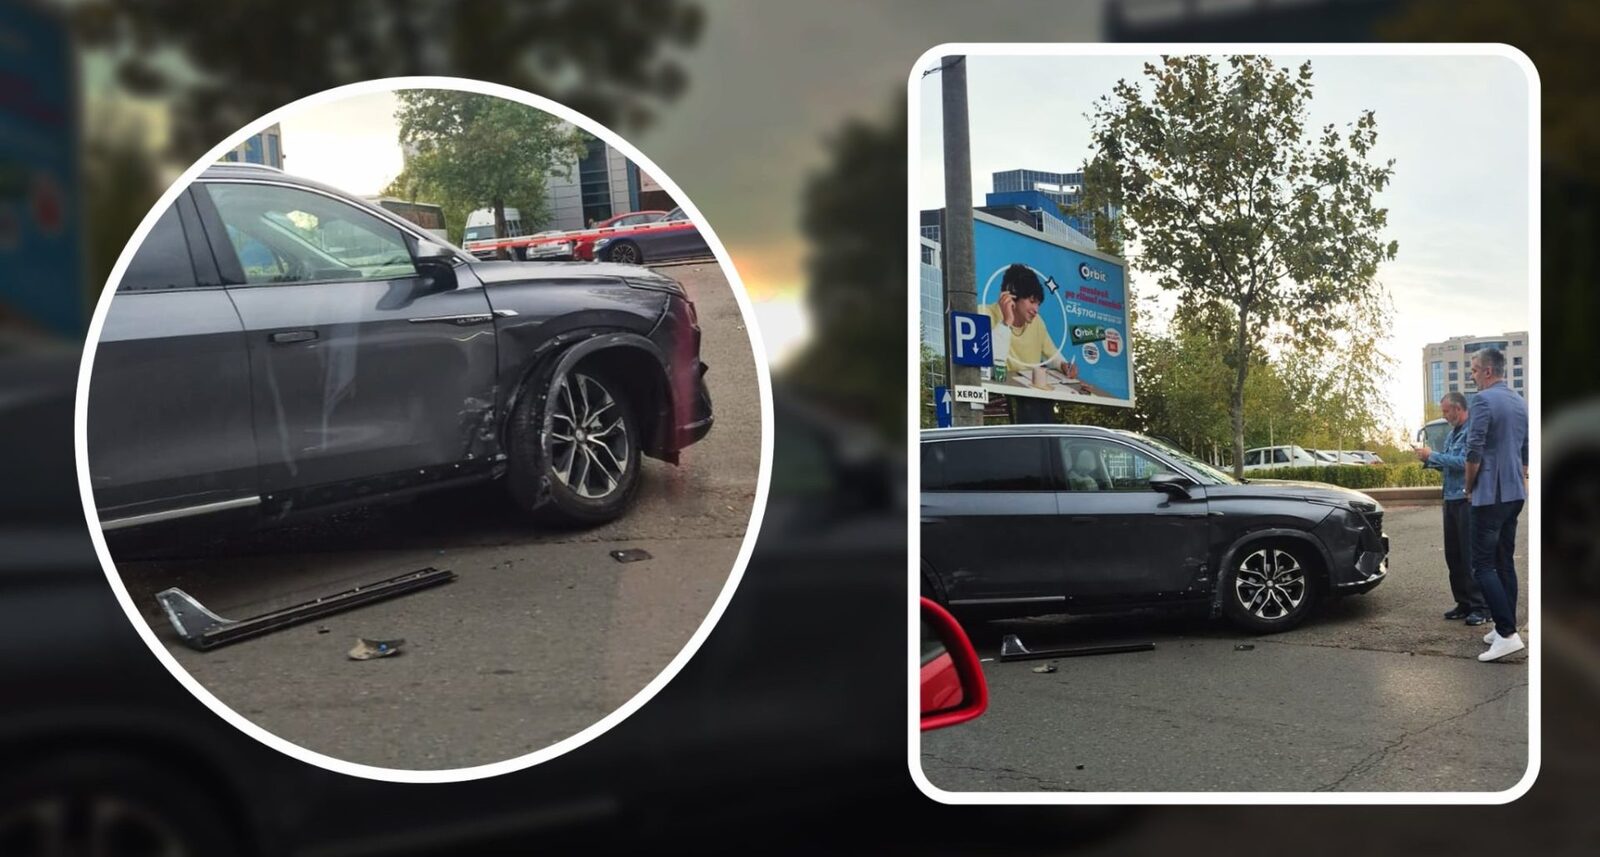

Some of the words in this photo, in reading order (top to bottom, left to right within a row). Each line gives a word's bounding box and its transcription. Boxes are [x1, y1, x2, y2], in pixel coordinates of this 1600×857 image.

[1081, 265, 1106, 282] Orbit
[954, 315, 976, 358] P
[1074, 327, 1093, 338] Orbit
[957, 389, 983, 399] XEROX
